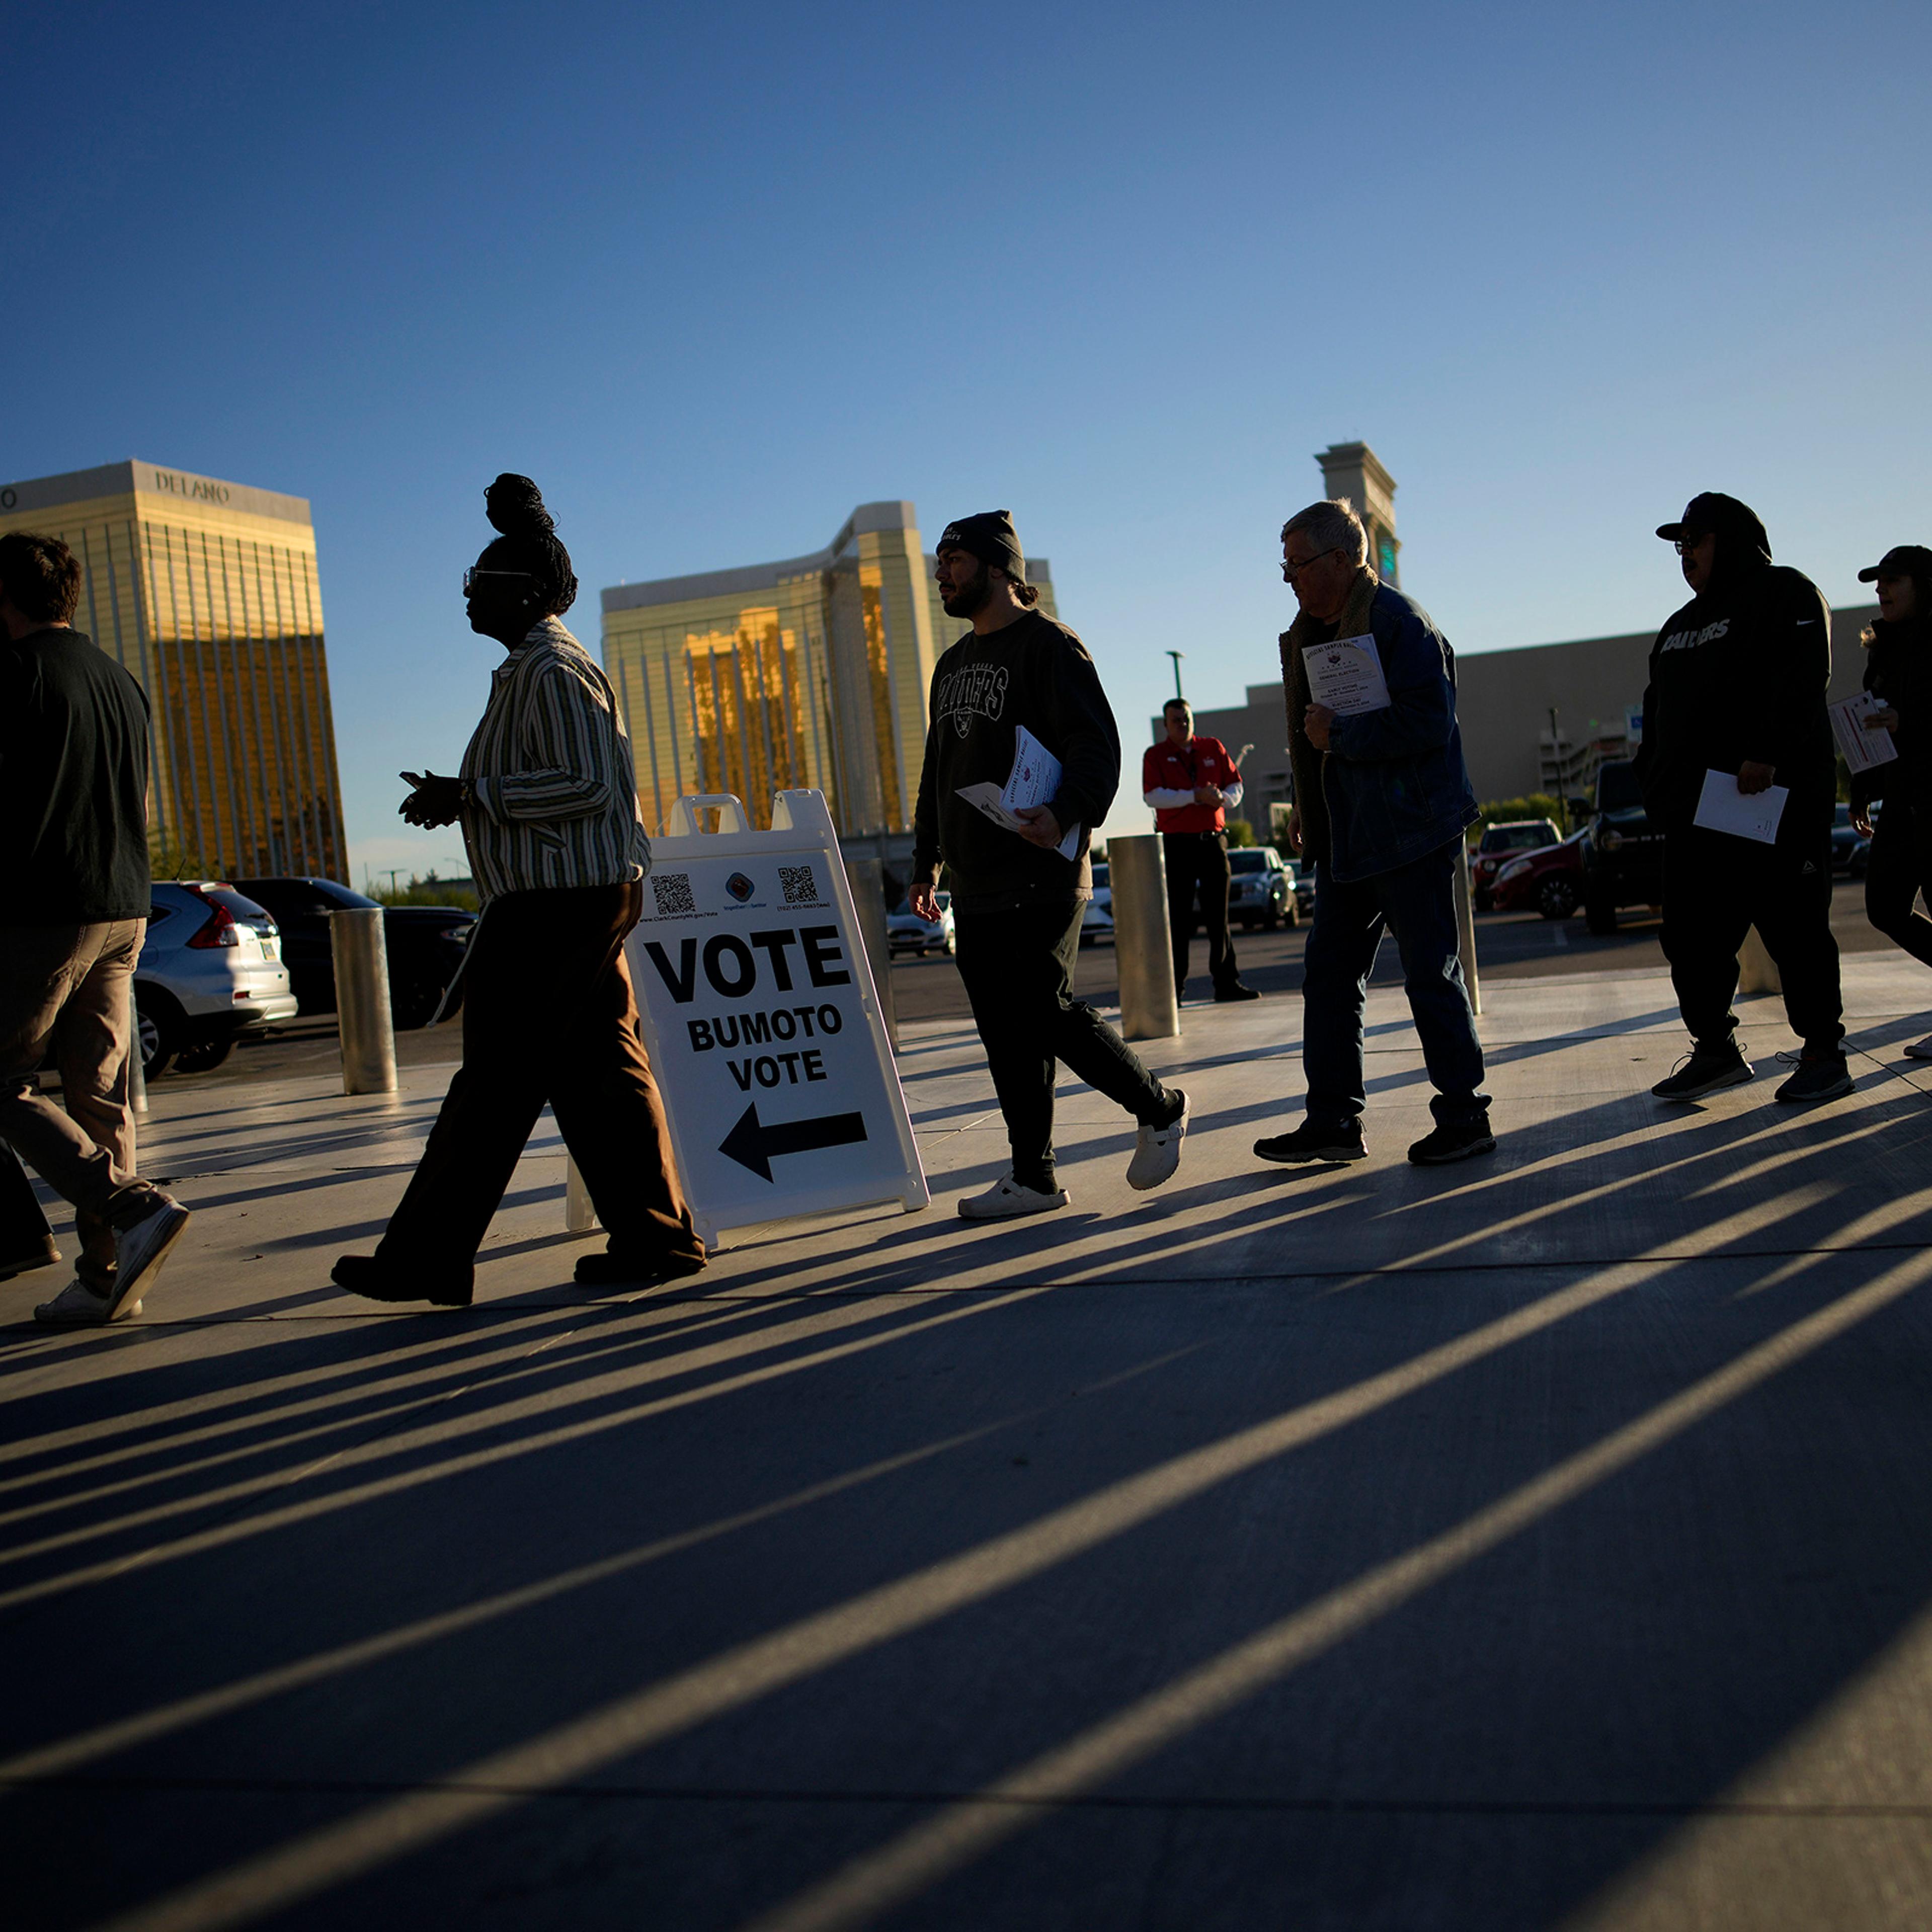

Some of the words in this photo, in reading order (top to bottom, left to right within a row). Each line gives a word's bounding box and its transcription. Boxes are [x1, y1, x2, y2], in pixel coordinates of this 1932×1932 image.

[155, 470, 230, 504] DELANO
[643, 925, 851, 1003] VOTE
[687, 1004, 842, 1052] BUMOTO
[726, 1049, 827, 1091] VOTE
